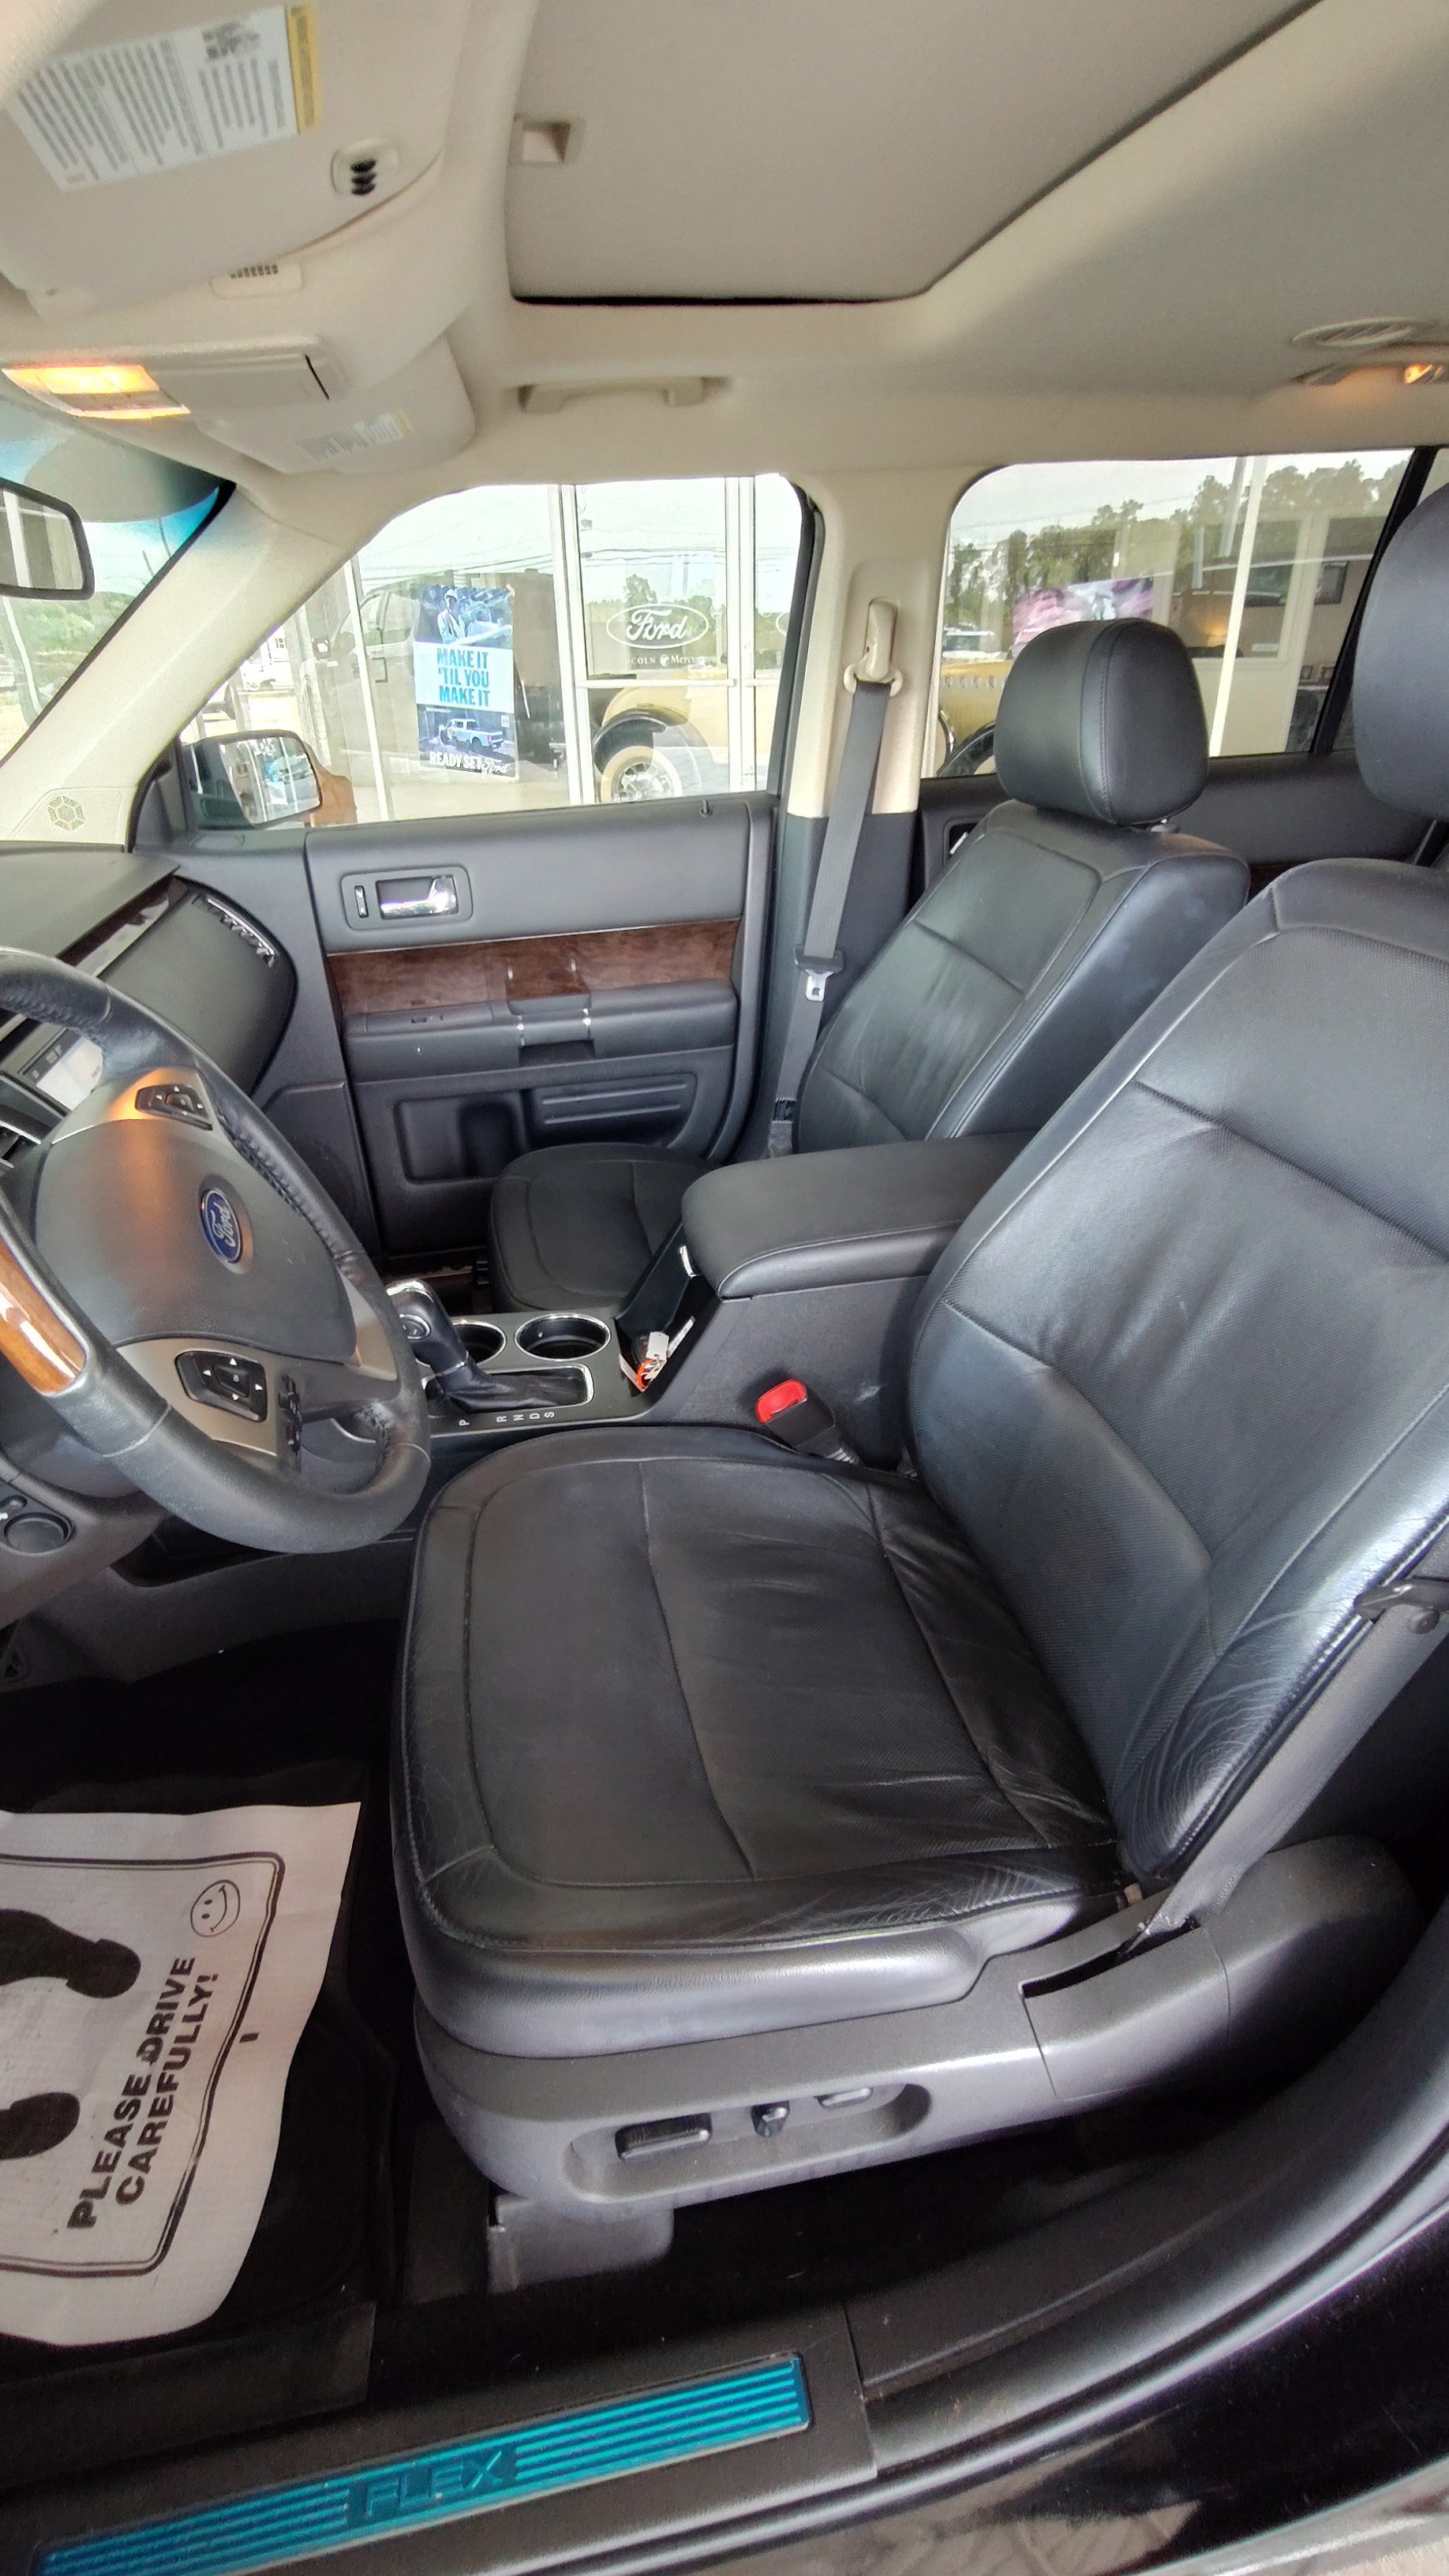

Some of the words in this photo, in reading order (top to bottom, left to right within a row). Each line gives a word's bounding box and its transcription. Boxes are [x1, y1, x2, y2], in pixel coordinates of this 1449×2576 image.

[626, 608, 688, 641] Ford
[436, 647, 474, 668] MAKE
[477, 651, 489, 669] IT
[464, 669, 489, 688] YOU
[439, 685, 476, 706] MAKE
[477, 690, 490, 707] IT
[429, 751, 462, 768] READY
[462, 754, 481, 770] SET
[210, 1201, 236, 1247] Ford
[67, 2074, 152, 2229] PLEASE
[136, 1957, 196, 2066] DRIVE
[115, 1974, 219, 2205] CAREFULLY!
[367, 2451, 503, 2517] FLEX
